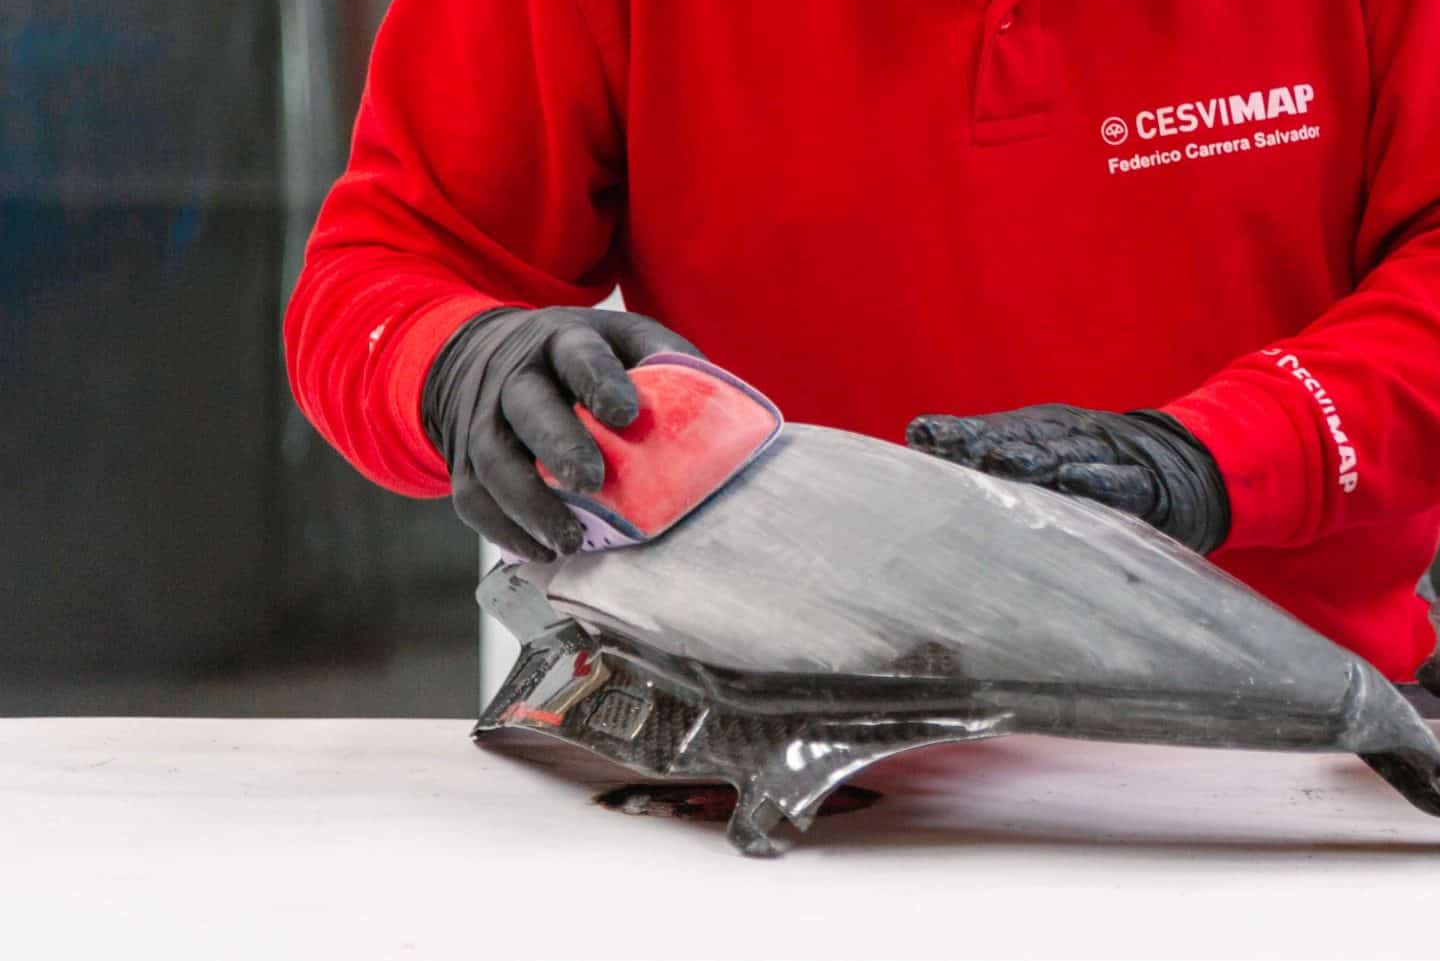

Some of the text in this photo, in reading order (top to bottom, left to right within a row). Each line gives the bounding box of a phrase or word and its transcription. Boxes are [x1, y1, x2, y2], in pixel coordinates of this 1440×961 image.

[1135, 83, 1314, 139] CESVIMAP
[1108, 124, 1320, 174] Federico Carrera Salvador
